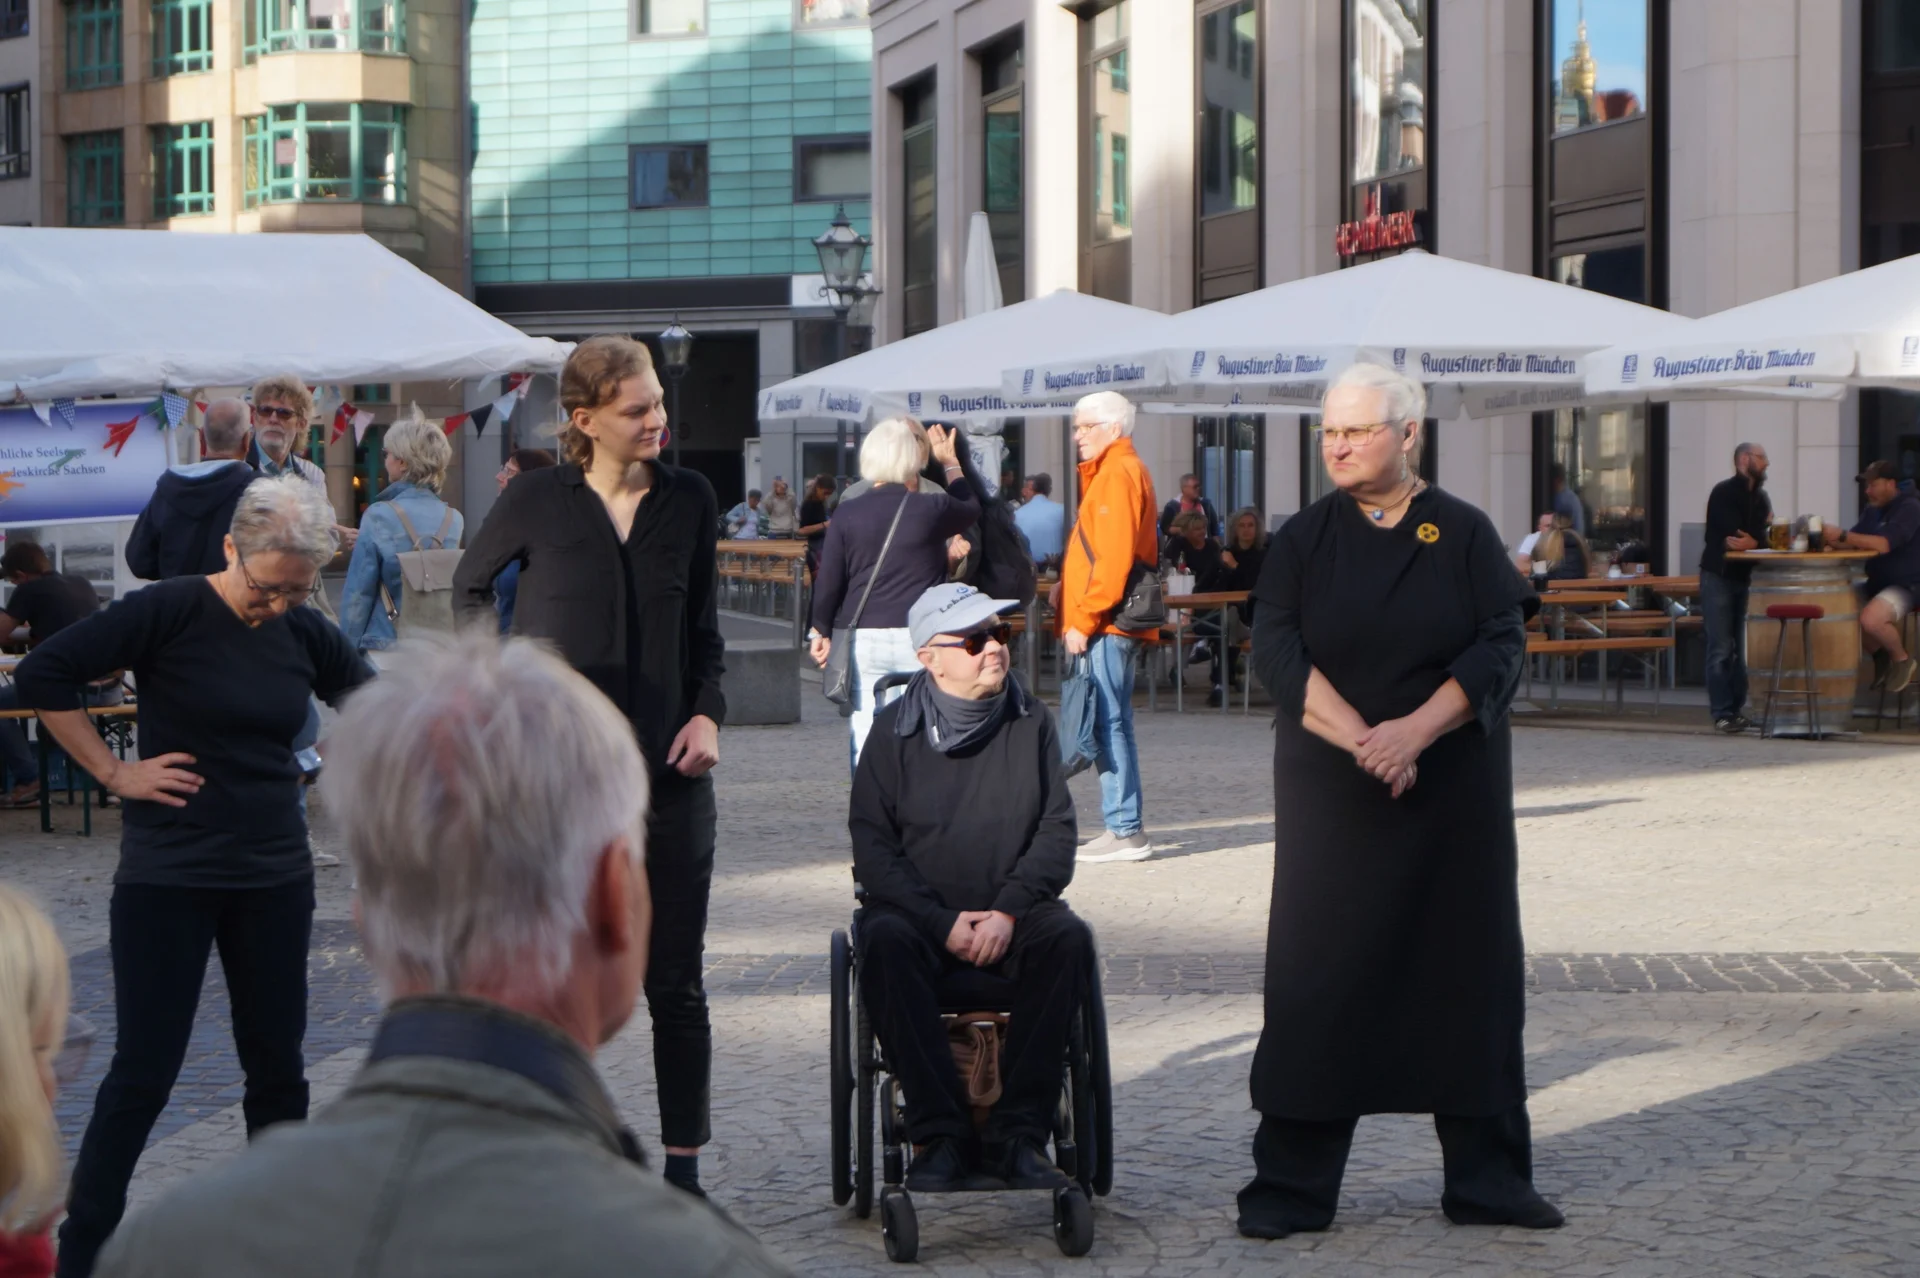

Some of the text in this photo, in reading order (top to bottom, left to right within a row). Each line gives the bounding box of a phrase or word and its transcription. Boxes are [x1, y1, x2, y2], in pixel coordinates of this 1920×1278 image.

[1525, 353, 1576, 374] München
[1765, 347, 1816, 369] München
[63, 463, 106, 476] Sachsen
